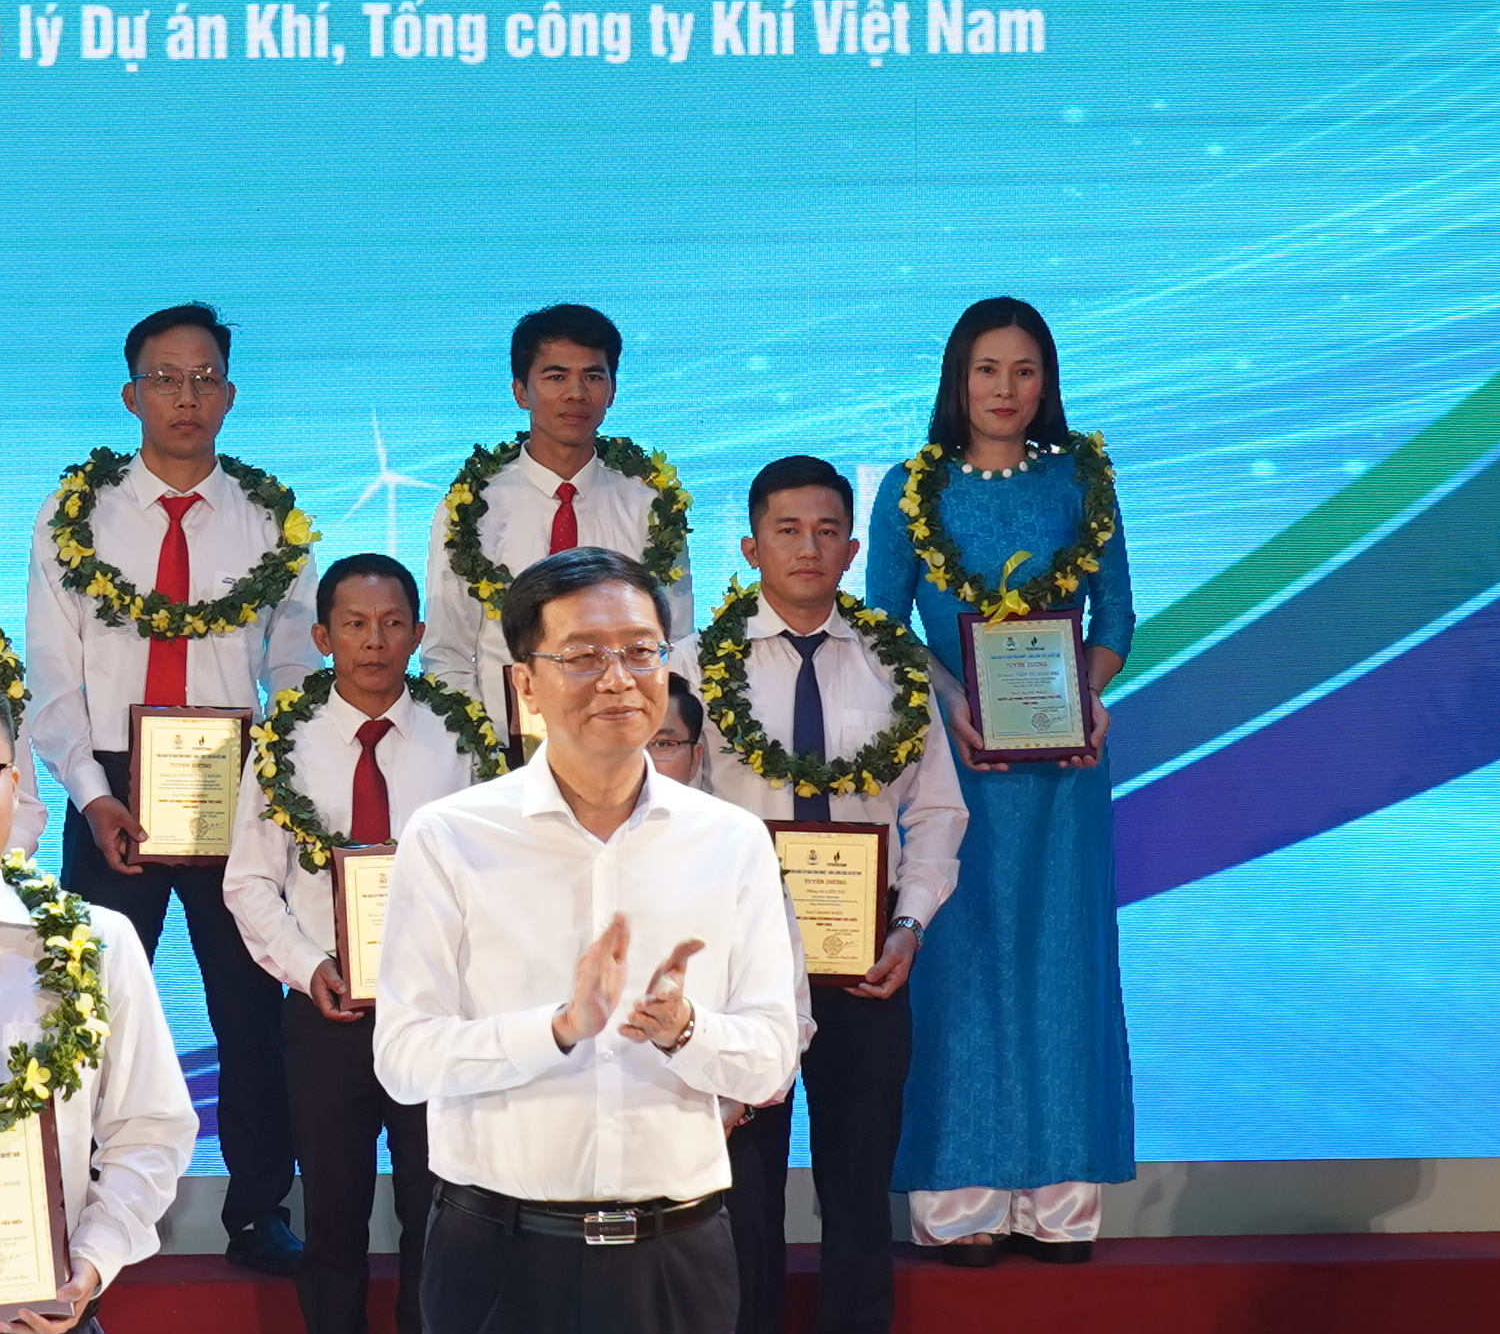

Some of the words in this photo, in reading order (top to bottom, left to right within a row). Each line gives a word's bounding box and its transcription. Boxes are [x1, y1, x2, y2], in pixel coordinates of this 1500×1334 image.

[18, 3, 64, 67] lý
[80, 4, 150, 72] Dự
[165, 3, 228, 61] án
[245, 2, 345, 65] Khí,
[505, 1, 633, 64] công
[650, 5, 696, 64] ty
[712, 0, 796, 57] Khí
[812, 0, 912, 68] Việt
